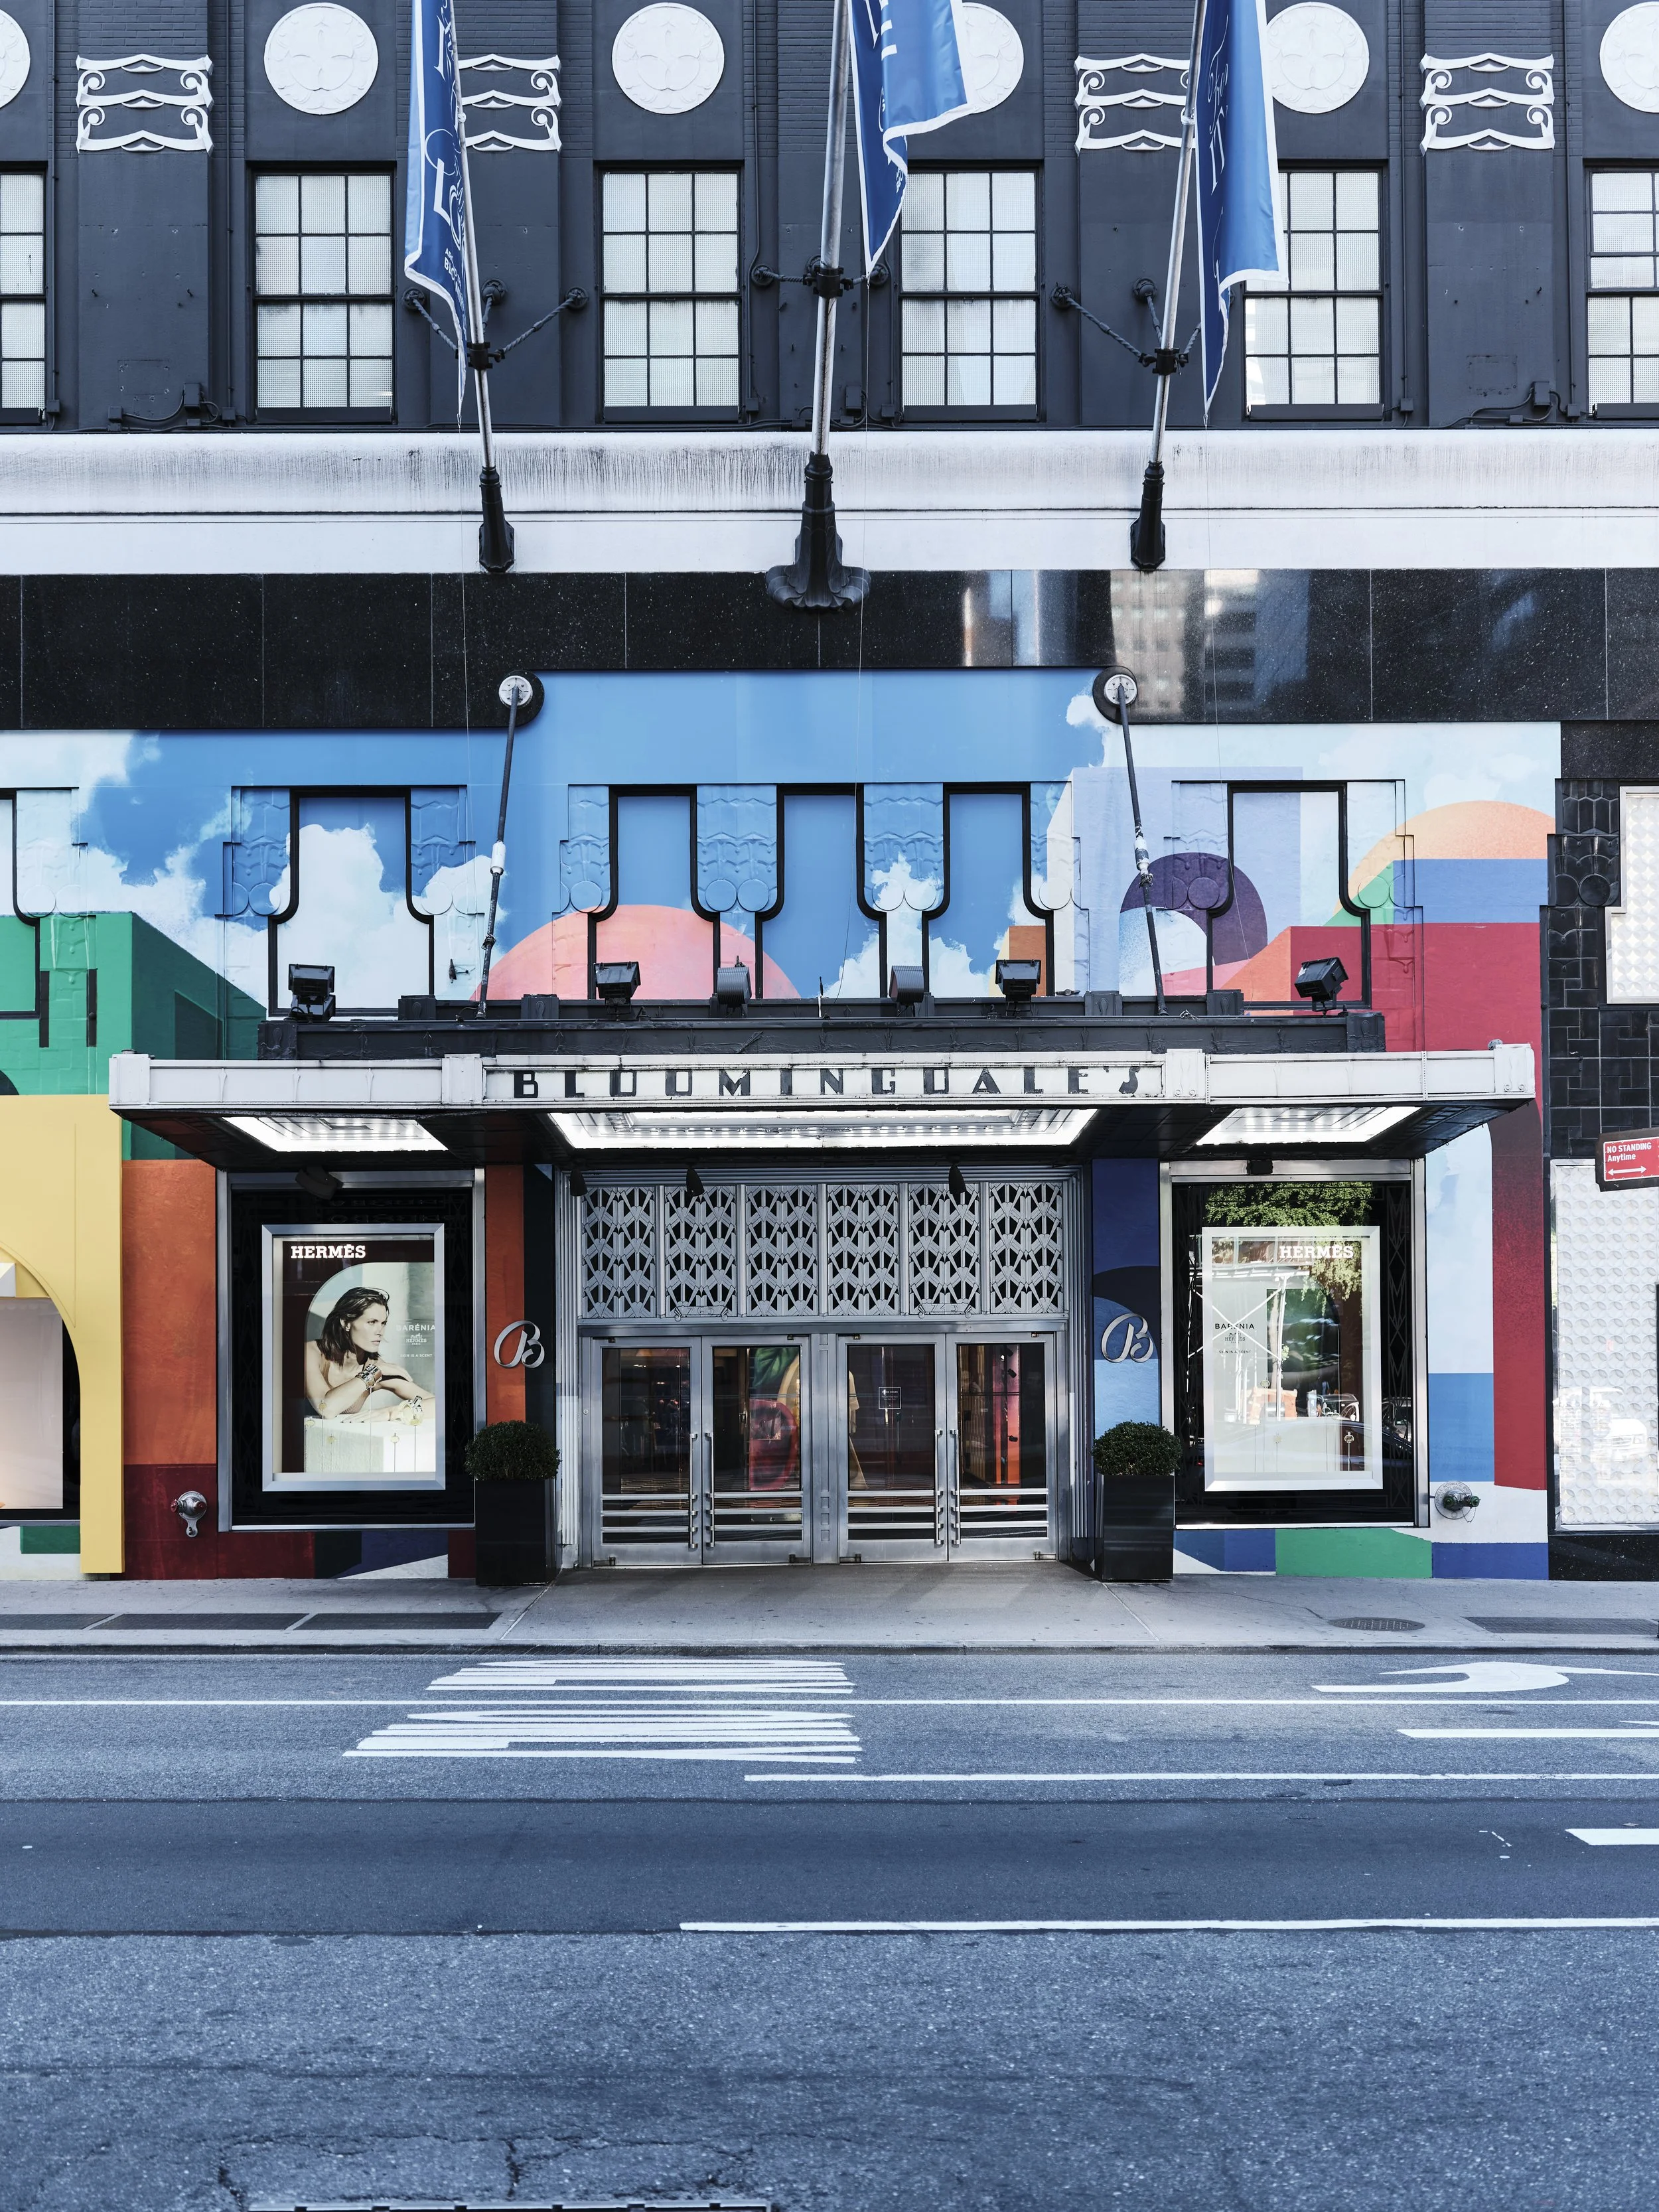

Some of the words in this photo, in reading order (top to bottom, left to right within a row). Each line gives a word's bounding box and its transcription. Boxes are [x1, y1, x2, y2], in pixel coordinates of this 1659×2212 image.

[514, 1065, 1141, 1098] BLOOMINGDALE'S
[1618, 1142, 1652, 1152] STANDING
[1607, 1153, 1636, 1163] Anytime
